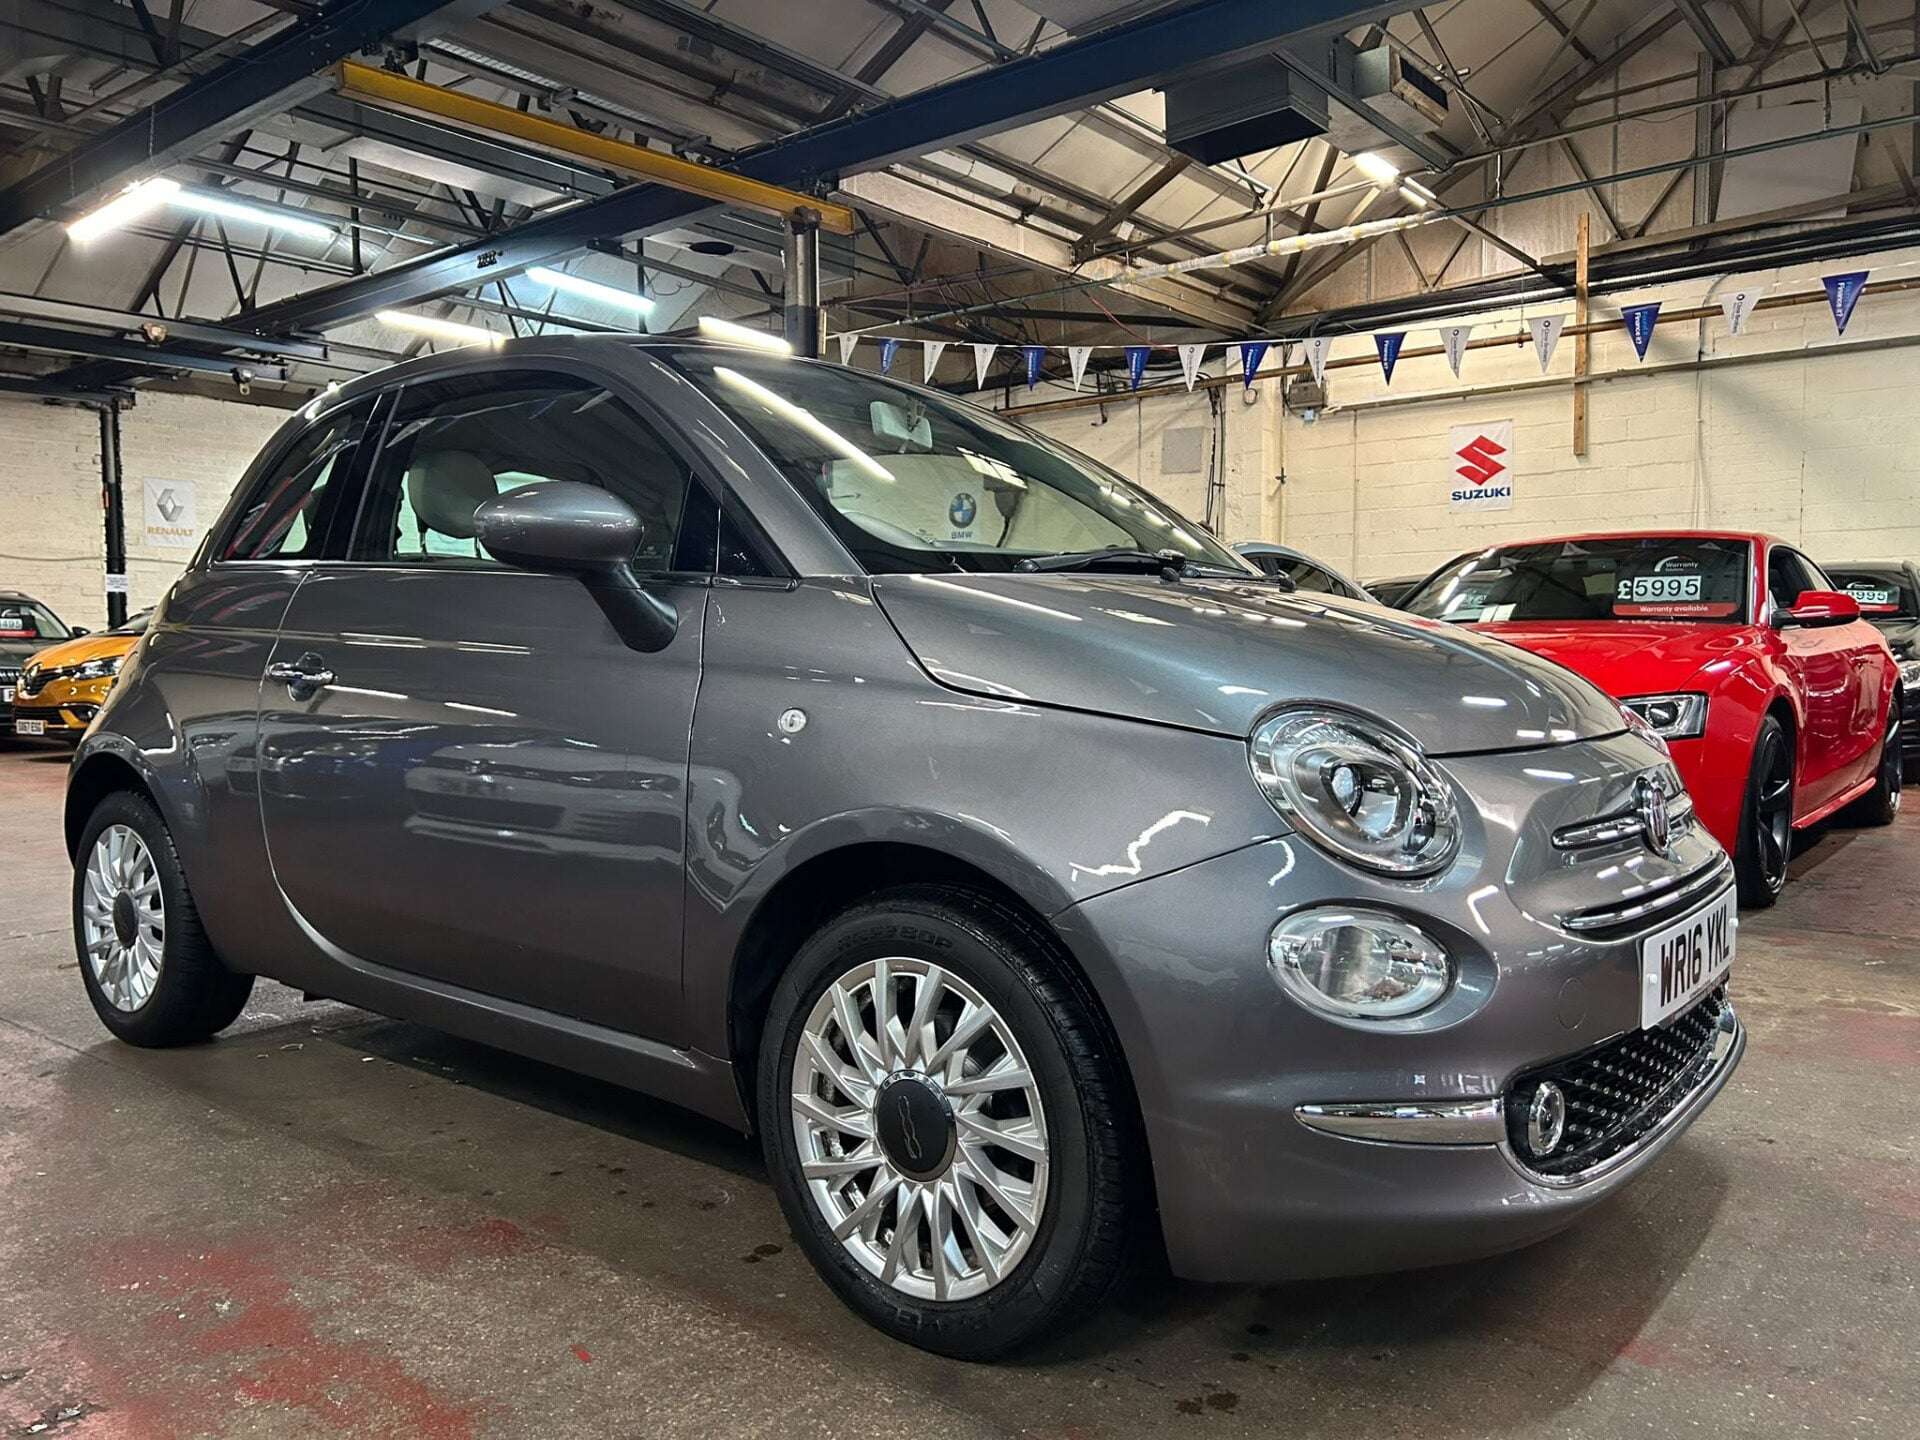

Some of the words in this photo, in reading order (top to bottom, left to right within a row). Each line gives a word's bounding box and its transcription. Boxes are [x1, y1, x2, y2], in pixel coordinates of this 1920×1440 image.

[1451, 486, 1511, 501] SUZUKI
[146, 525, 194, 537] RENAULT
[1617, 577, 1699, 600] £5995
[1660, 923, 1703, 1008] WR16
[1707, 903, 1730, 973] YKL
